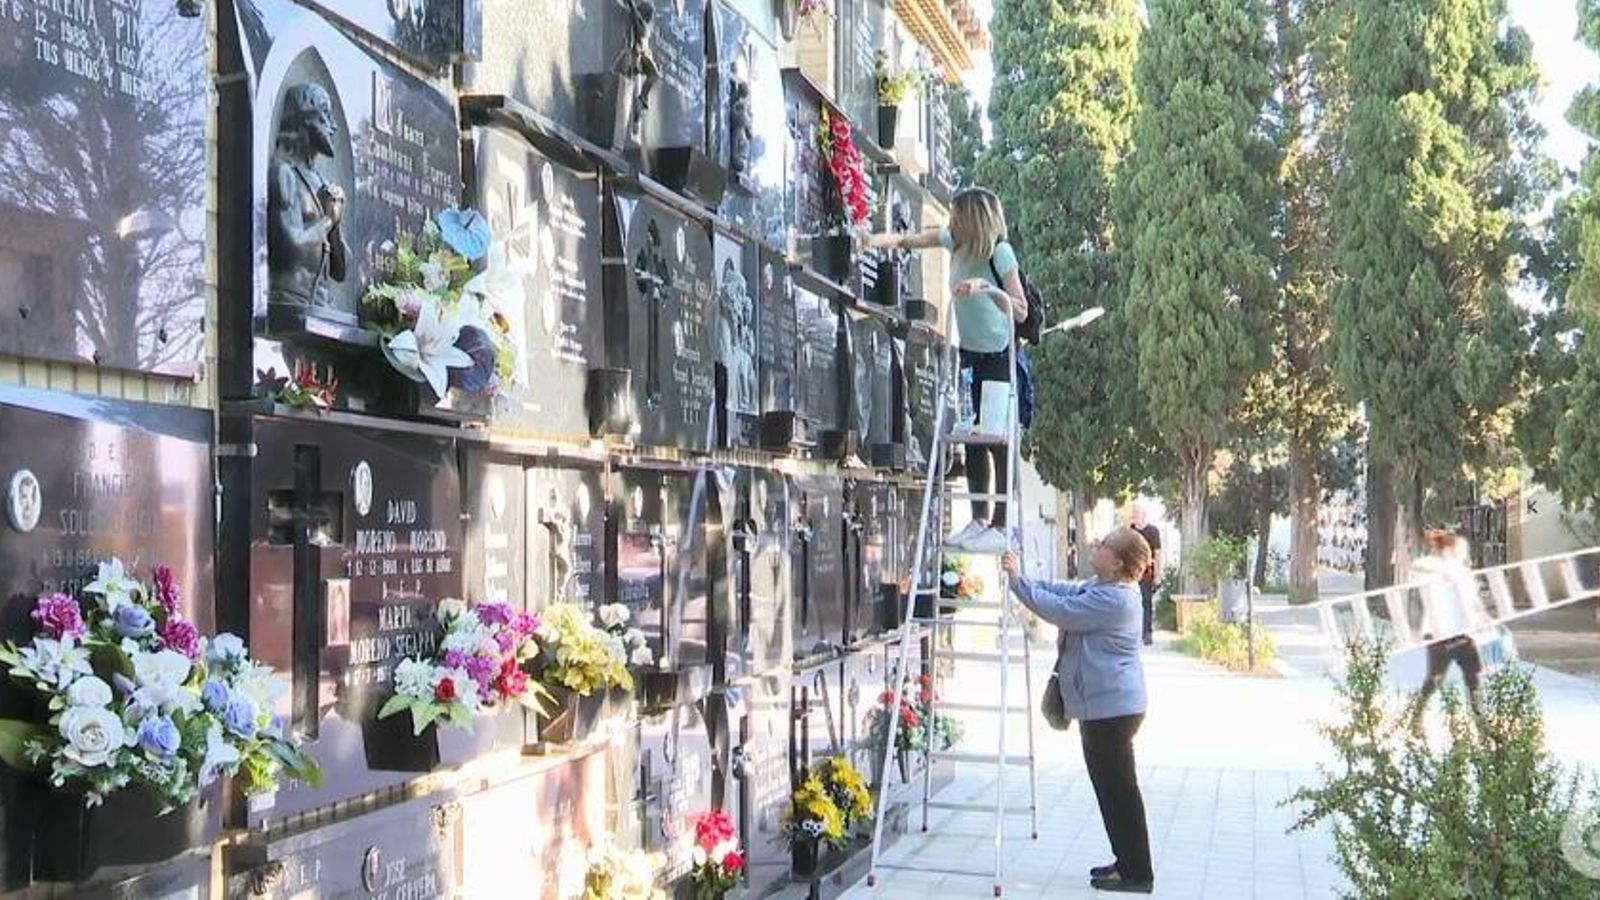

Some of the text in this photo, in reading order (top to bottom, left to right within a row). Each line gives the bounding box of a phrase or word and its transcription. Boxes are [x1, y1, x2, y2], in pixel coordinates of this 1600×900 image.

[34, 37, 58, 65] TUS
[63, 49, 100, 82] HIJOS
[386, 499, 417, 524] DAVID
[1527, 499, 1538, 514] K
[355, 529, 447, 554] MORENO MORENO
[379, 604, 413, 632] MARTA
[348, 636, 391, 665] MORENO
